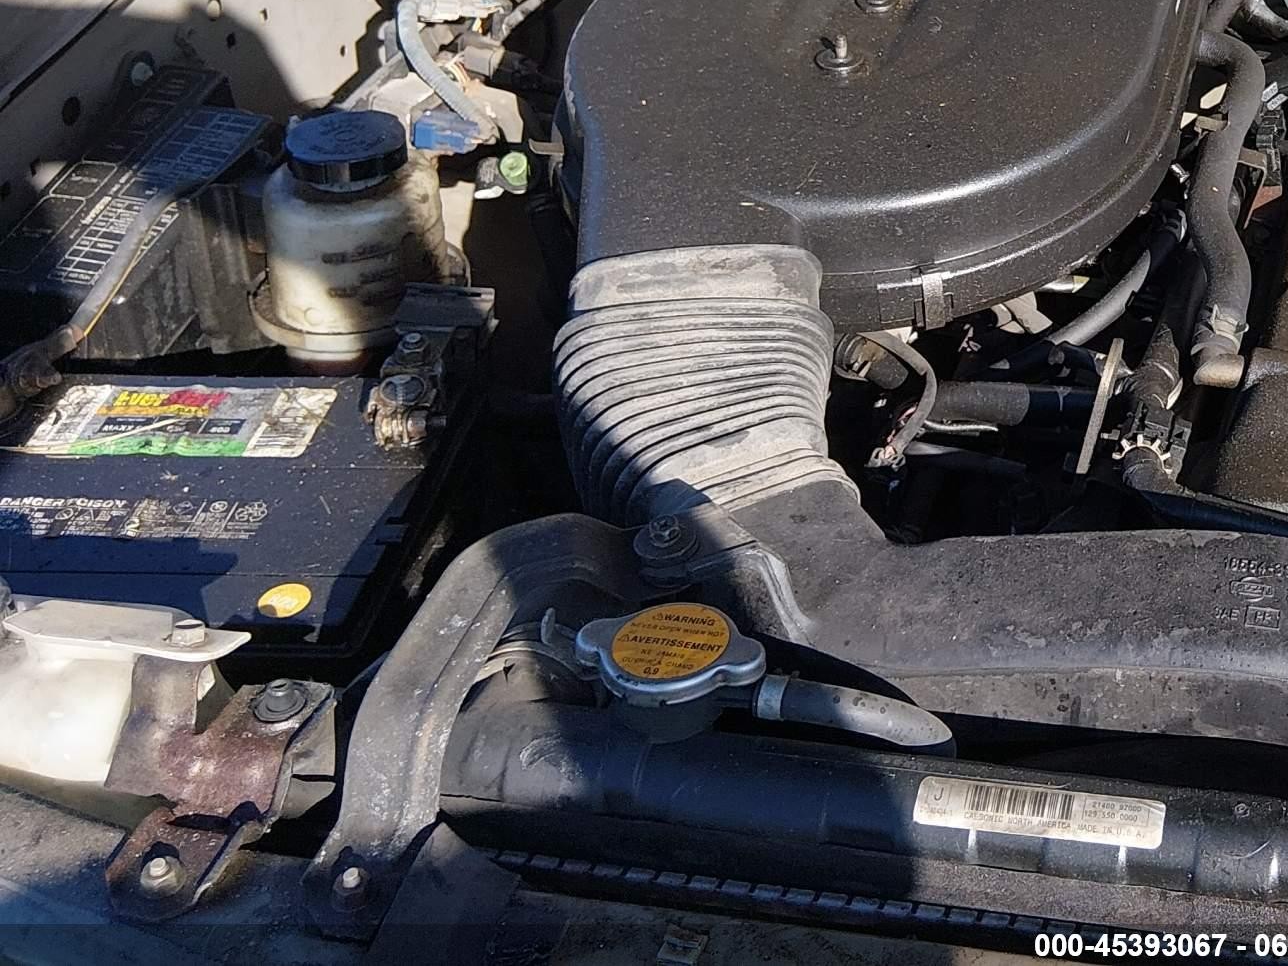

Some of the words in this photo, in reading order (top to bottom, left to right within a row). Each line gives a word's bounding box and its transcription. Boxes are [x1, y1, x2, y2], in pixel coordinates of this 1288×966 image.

[0, 496, 64, 507] DANGER
[664, 613, 716, 627] WARNING
[631, 622, 658, 630] NEVER
[659, 625, 682, 633] OPEN
[630, 635, 723, 652] AVERTISSEMENT
[934, 787, 945, 801] J
[963, 811, 1004, 823] CALSONIC
[1007, 816, 1033, 826] NORTH
[1037, 820, 1071, 830] AMERICA
[1077, 824, 1098, 833] MADE
[1103, 826, 1113, 834] IN
